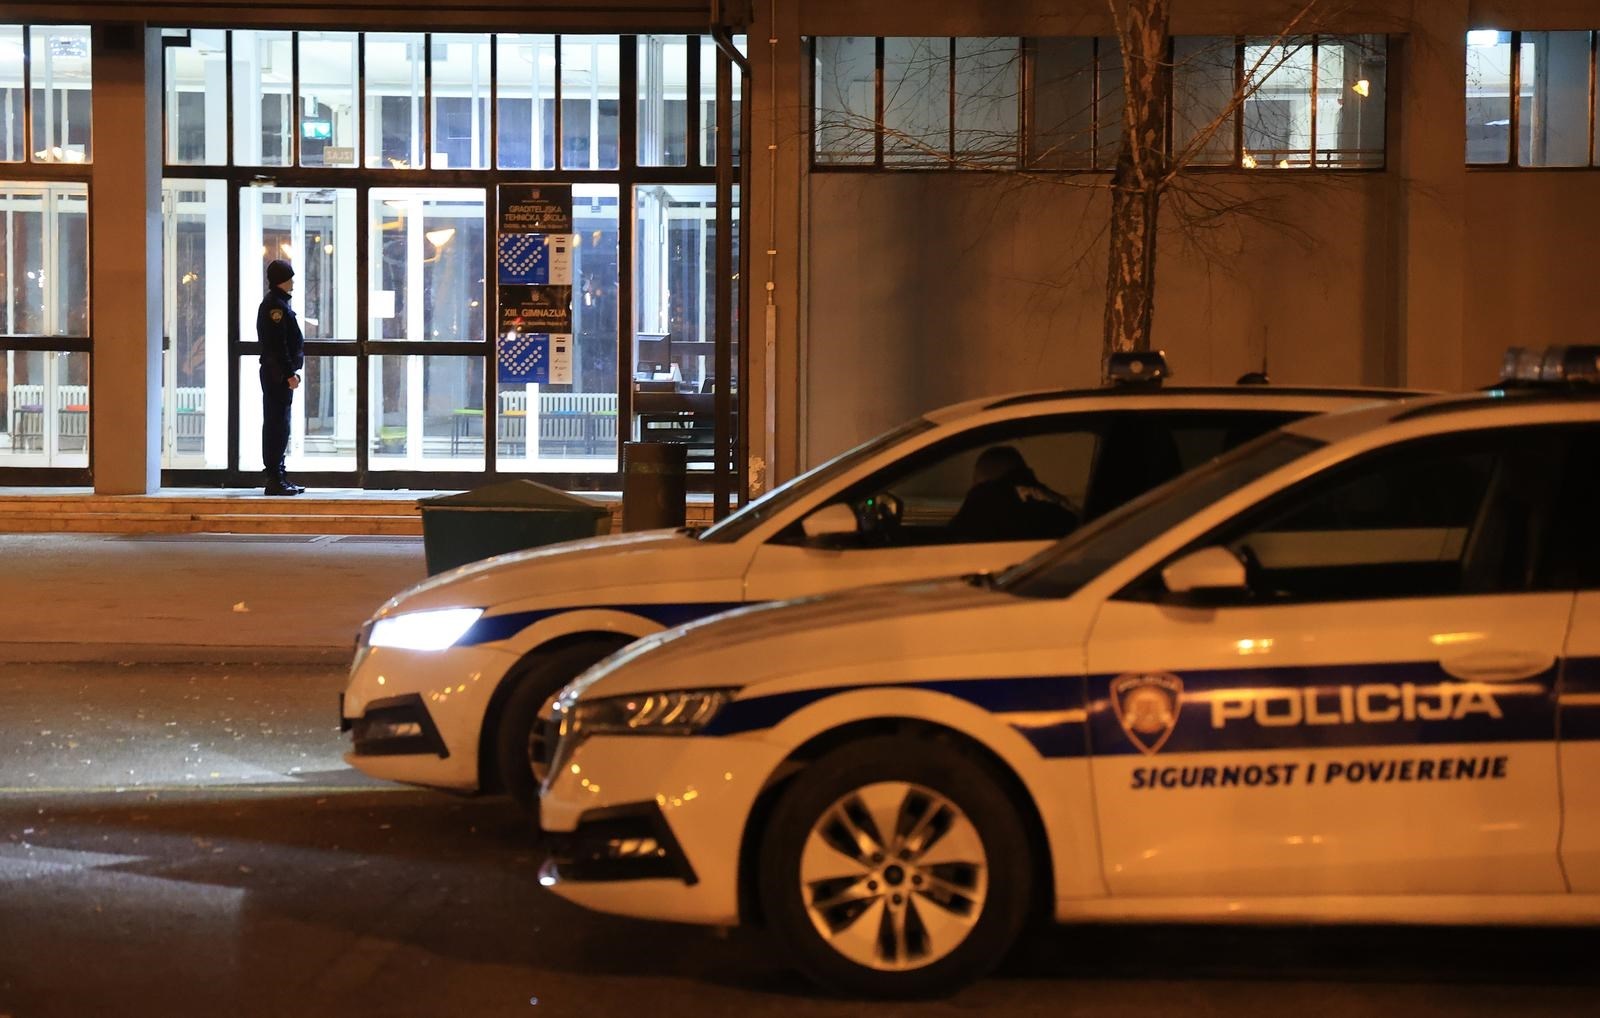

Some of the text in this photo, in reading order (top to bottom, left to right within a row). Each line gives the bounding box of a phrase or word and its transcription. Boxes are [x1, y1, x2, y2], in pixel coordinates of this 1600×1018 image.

[508, 205, 562, 213] GRADITELJSKA
[504, 213, 567, 221] TEHNIČKA ŠKOLA
[521, 308, 567, 317] GIMNAZIJA
[1210, 682, 1503, 729] POLICIJA
[1131, 756, 1508, 790] SIGURNOST I POVJERENJE
